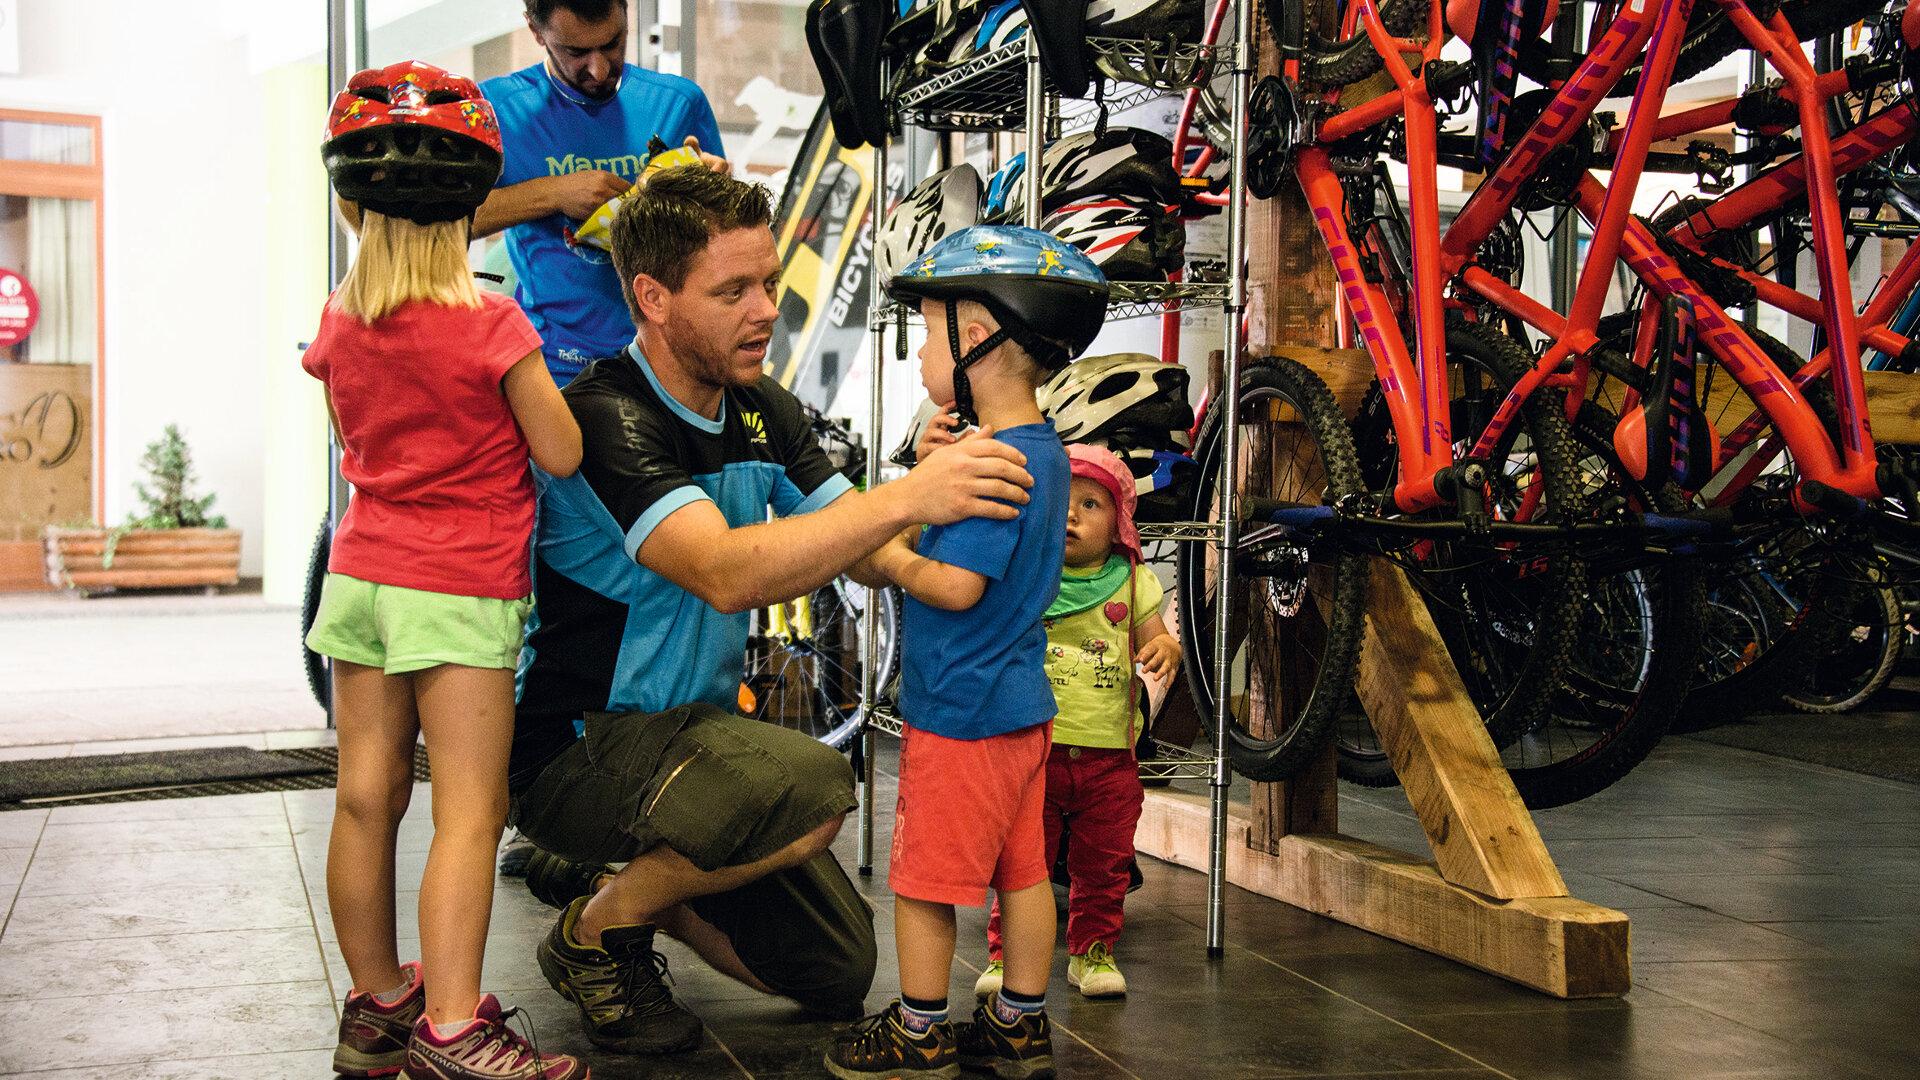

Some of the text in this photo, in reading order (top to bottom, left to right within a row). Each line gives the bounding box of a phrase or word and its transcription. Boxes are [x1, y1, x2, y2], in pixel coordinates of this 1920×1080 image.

[1490, 16, 1642, 203] GHOST
[545, 153, 651, 178] Marmo
[1313, 206, 1407, 404] GHOST
[415, 1041, 465, 1075] SALOMON
